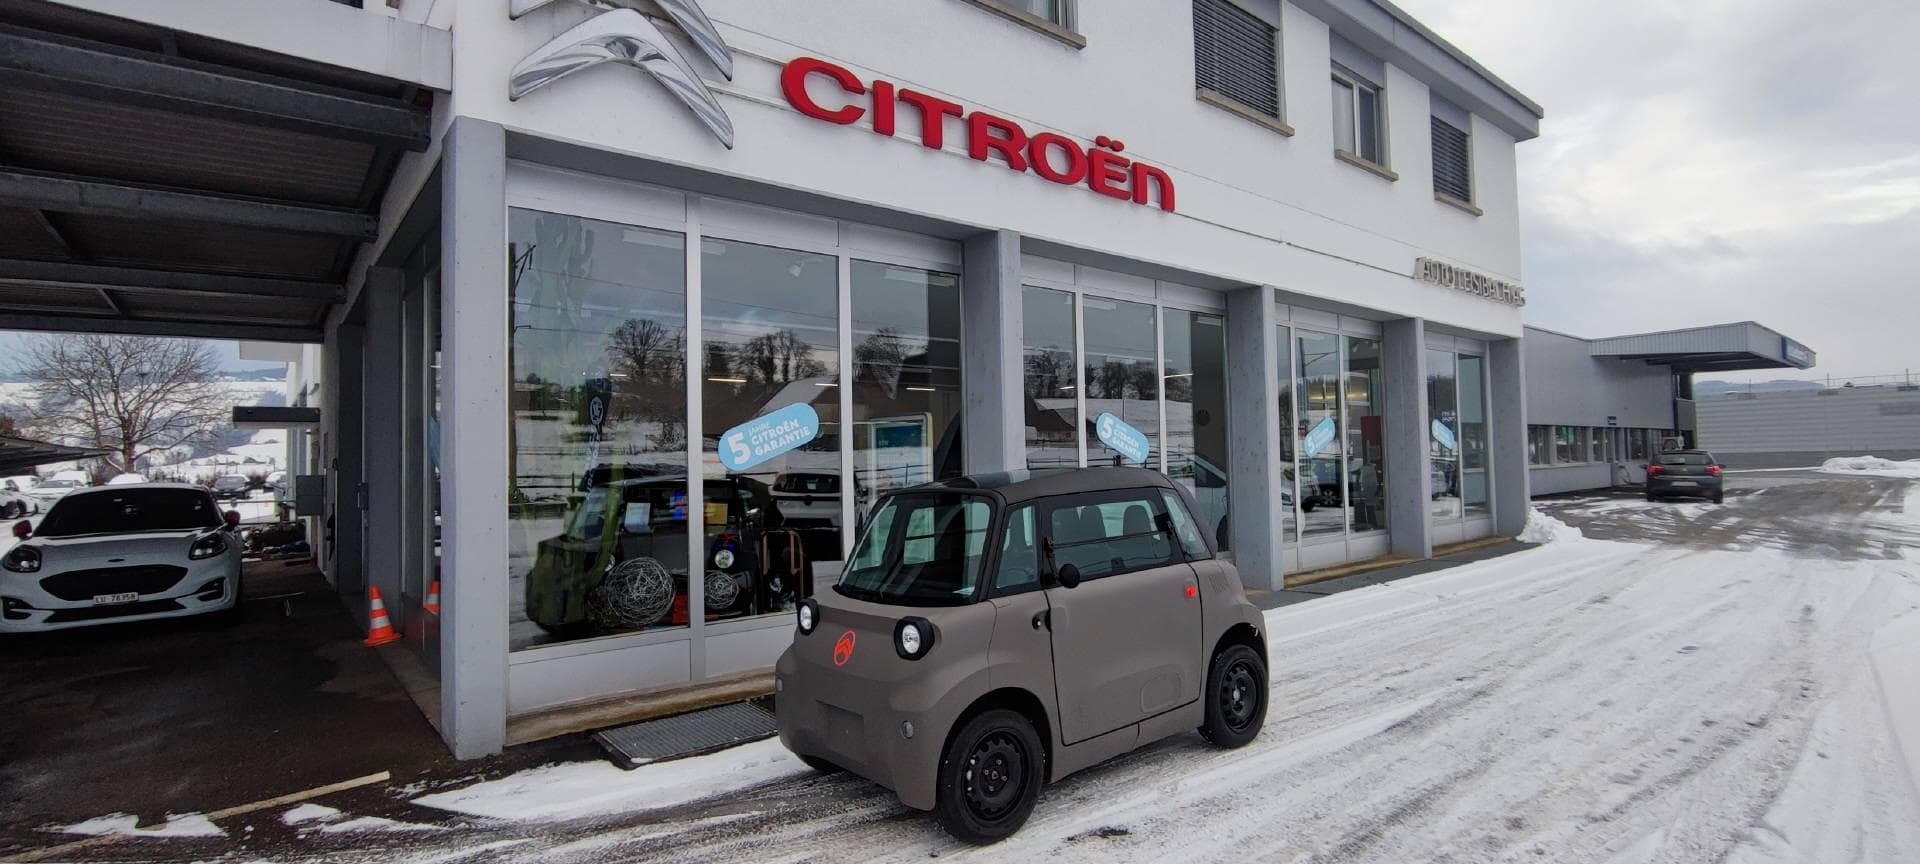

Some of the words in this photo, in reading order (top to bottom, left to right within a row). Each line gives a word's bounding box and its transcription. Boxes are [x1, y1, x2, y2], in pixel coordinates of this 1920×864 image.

[755, 426, 811, 456] GARANTIE
[1101, 416, 1114, 439] 5
[727, 431, 751, 465] 5
